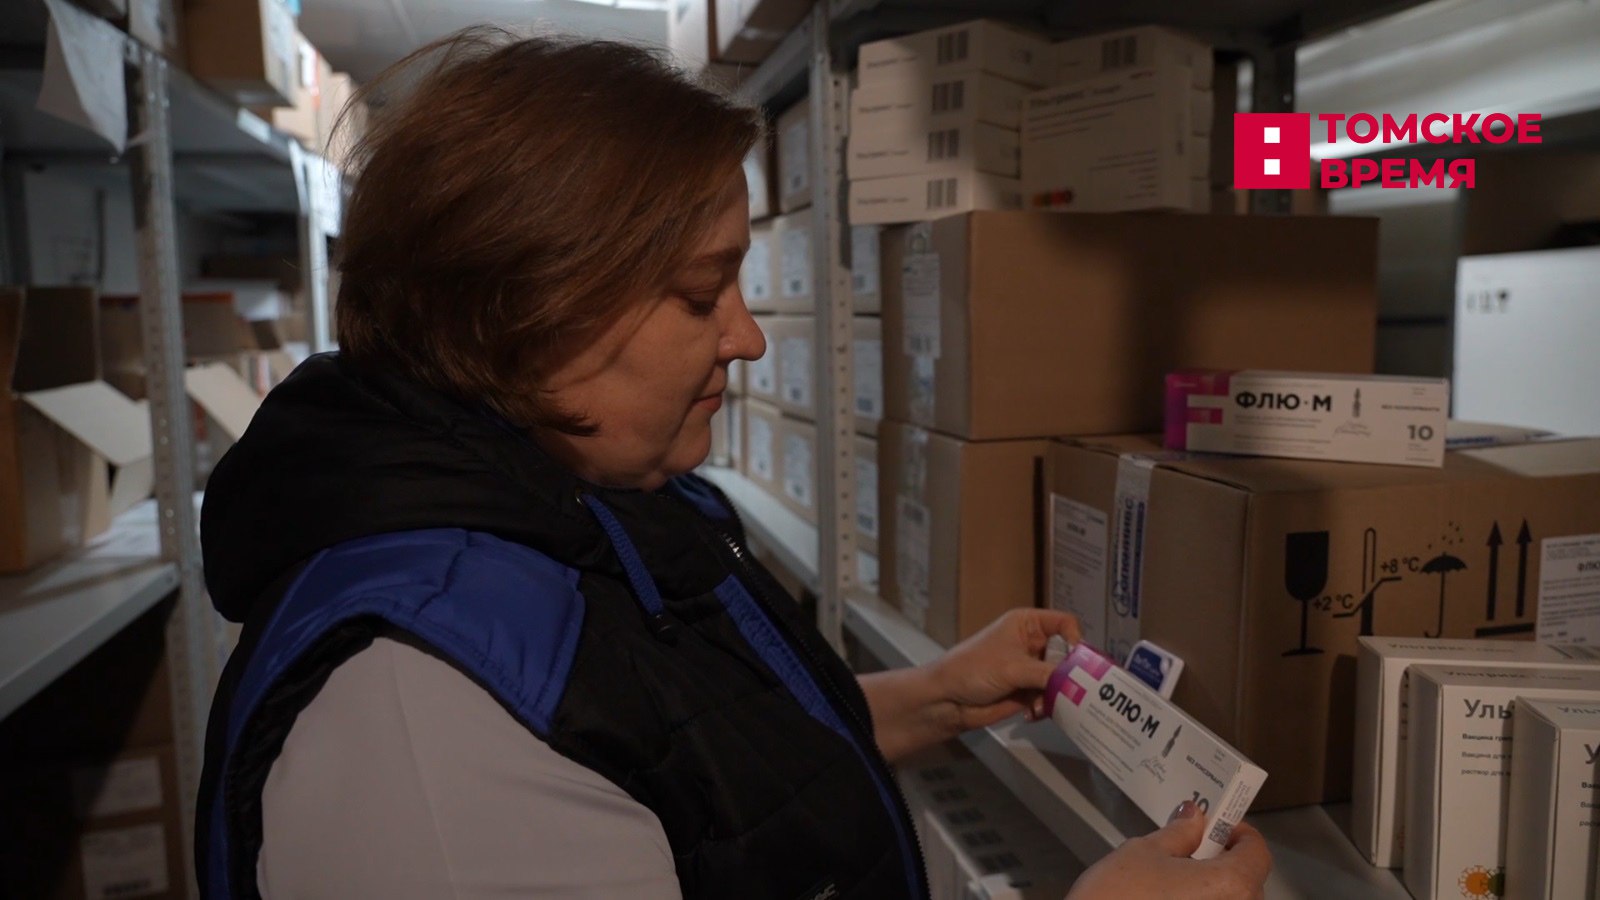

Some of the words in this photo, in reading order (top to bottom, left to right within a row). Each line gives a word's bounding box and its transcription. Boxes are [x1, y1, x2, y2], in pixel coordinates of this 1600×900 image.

[1407, 424, 1434, 441] 10
[1381, 557, 1399, 574] +8
[1313, 595, 1332, 611] +2
[1463, 699, 1514, 719] Уль
